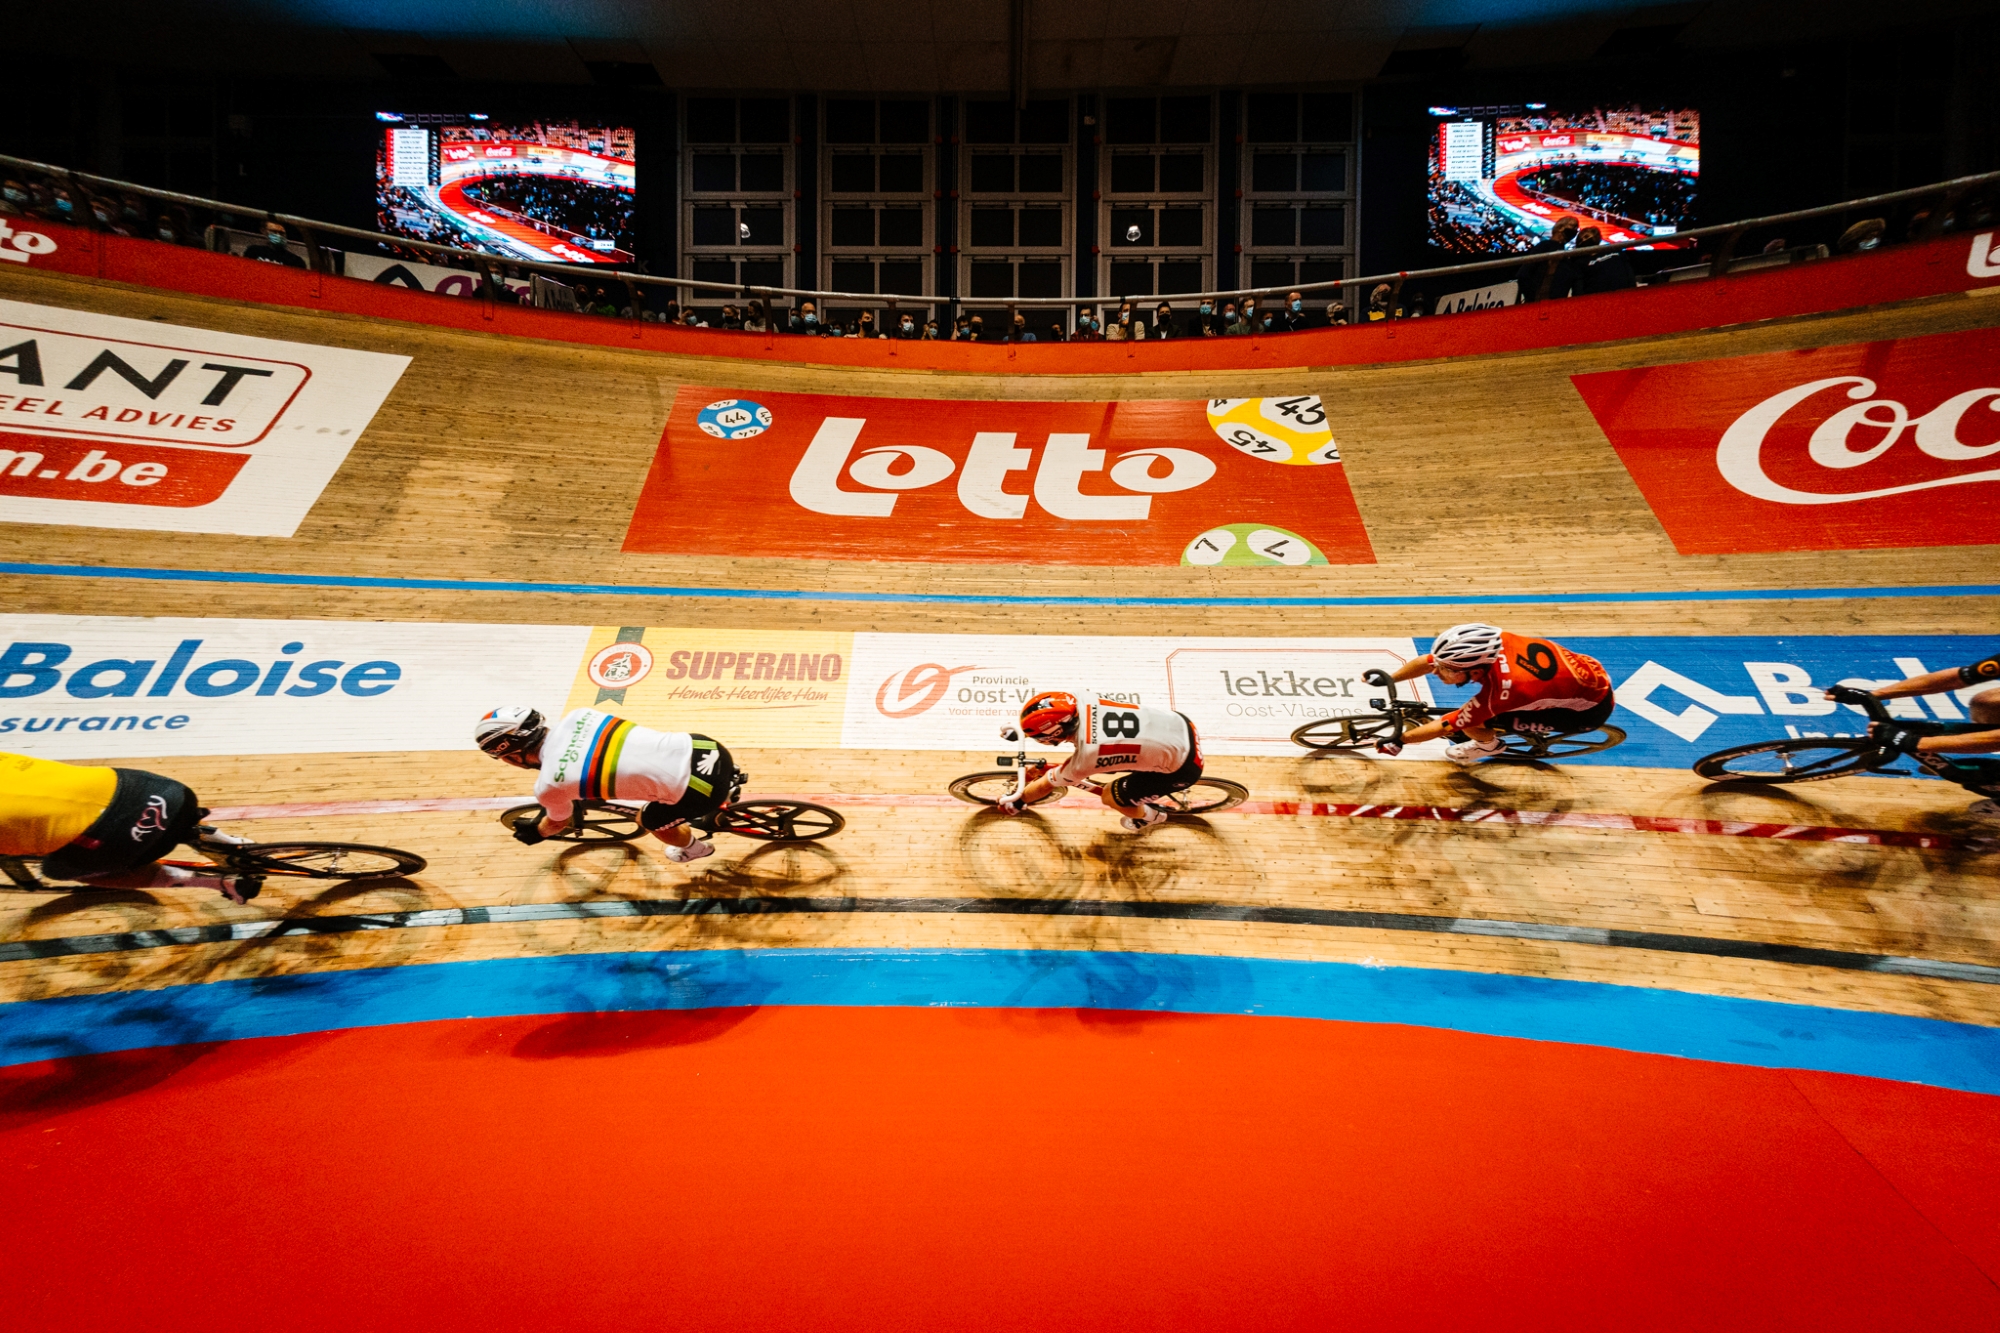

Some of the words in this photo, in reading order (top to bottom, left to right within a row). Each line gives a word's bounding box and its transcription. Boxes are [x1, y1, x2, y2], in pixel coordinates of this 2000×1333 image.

[81, 405, 236, 432] ADVIES
[725, 411, 746, 424] 44
[0, 639, 401, 699] Baloise
[666, 650, 843, 682] SUPERANO
[972, 675, 1029, 686] Provincie
[1219, 670, 1354, 698] lekker
[668, 685, 726, 701] Hemels
[723, 686, 791, 704] Heerlijke
[788, 687, 829, 702] Ham
[1102, 711, 1140, 738] 8
[1095, 755, 1138, 769] SOUDAL
